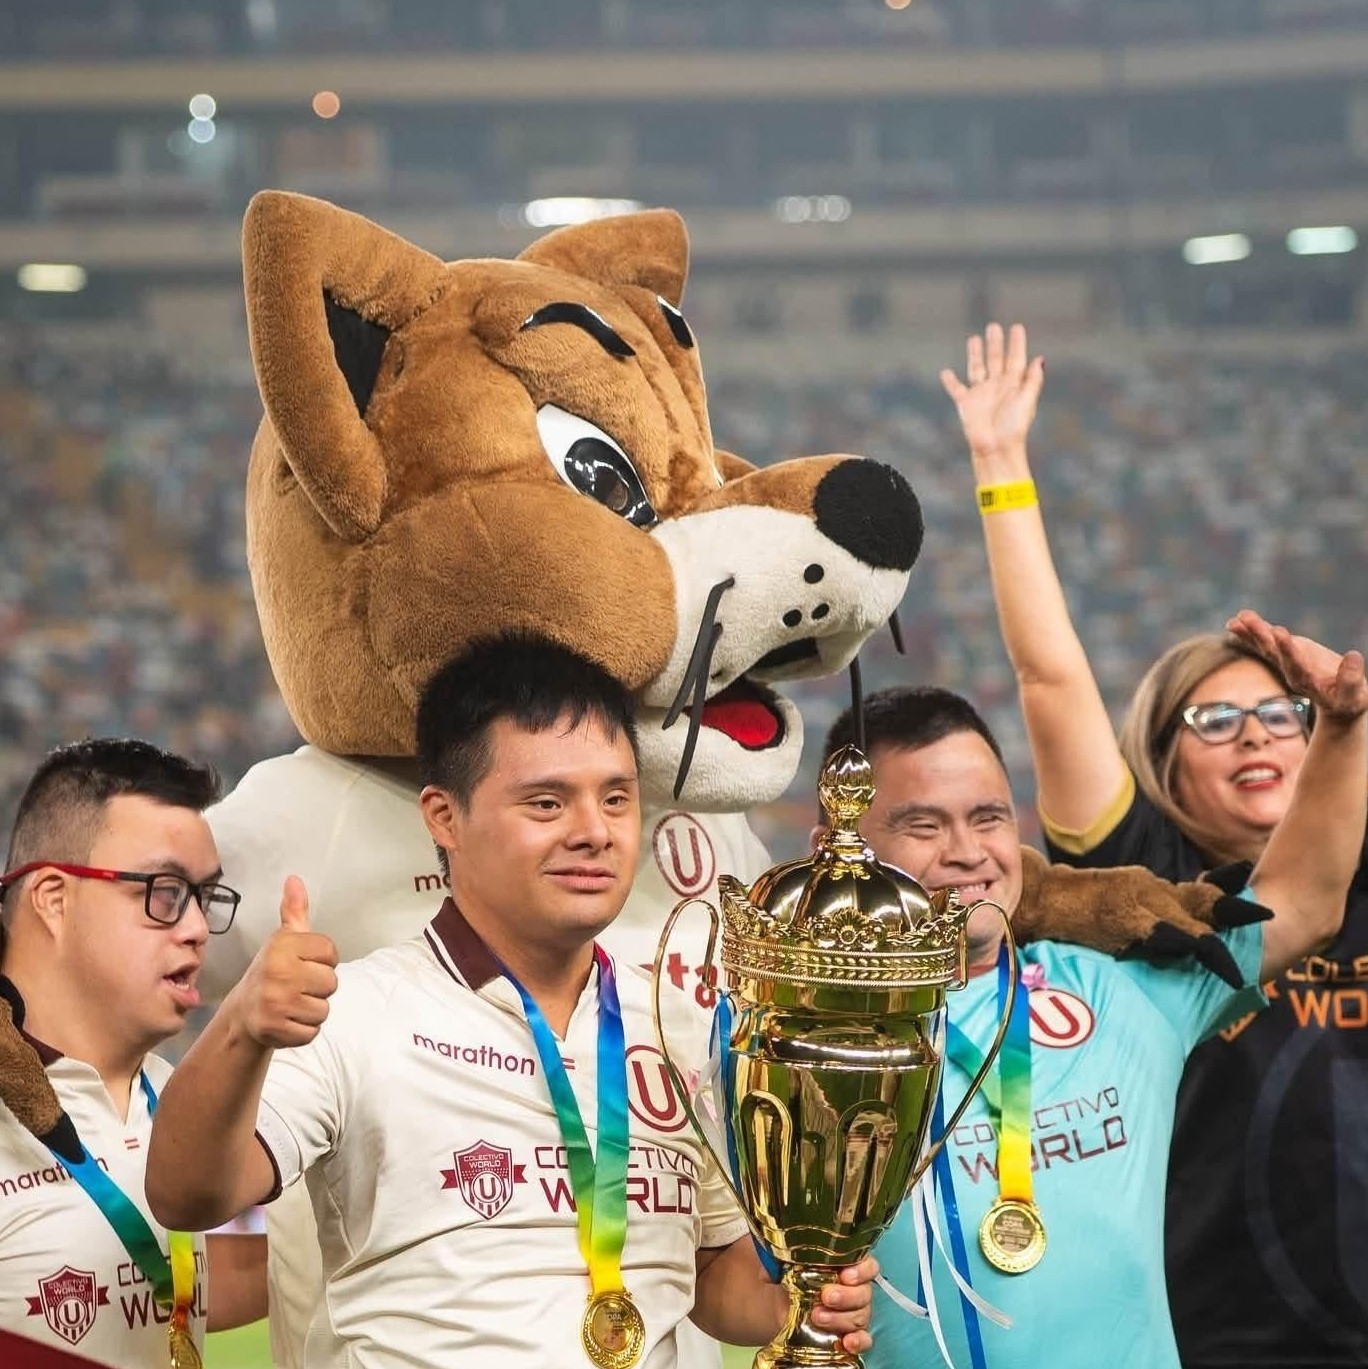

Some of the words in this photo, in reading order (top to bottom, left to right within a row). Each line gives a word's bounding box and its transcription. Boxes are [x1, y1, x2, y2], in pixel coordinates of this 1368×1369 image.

[667, 828, 702, 887] U
[413, 1033, 535, 1076] marathon
[632, 1061, 677, 1120] U
[469, 1160, 501, 1169] WORLD
[479, 1177, 496, 1200] U
[538, 1177, 693, 1214] WRLD
[64, 1302, 80, 1325] U
